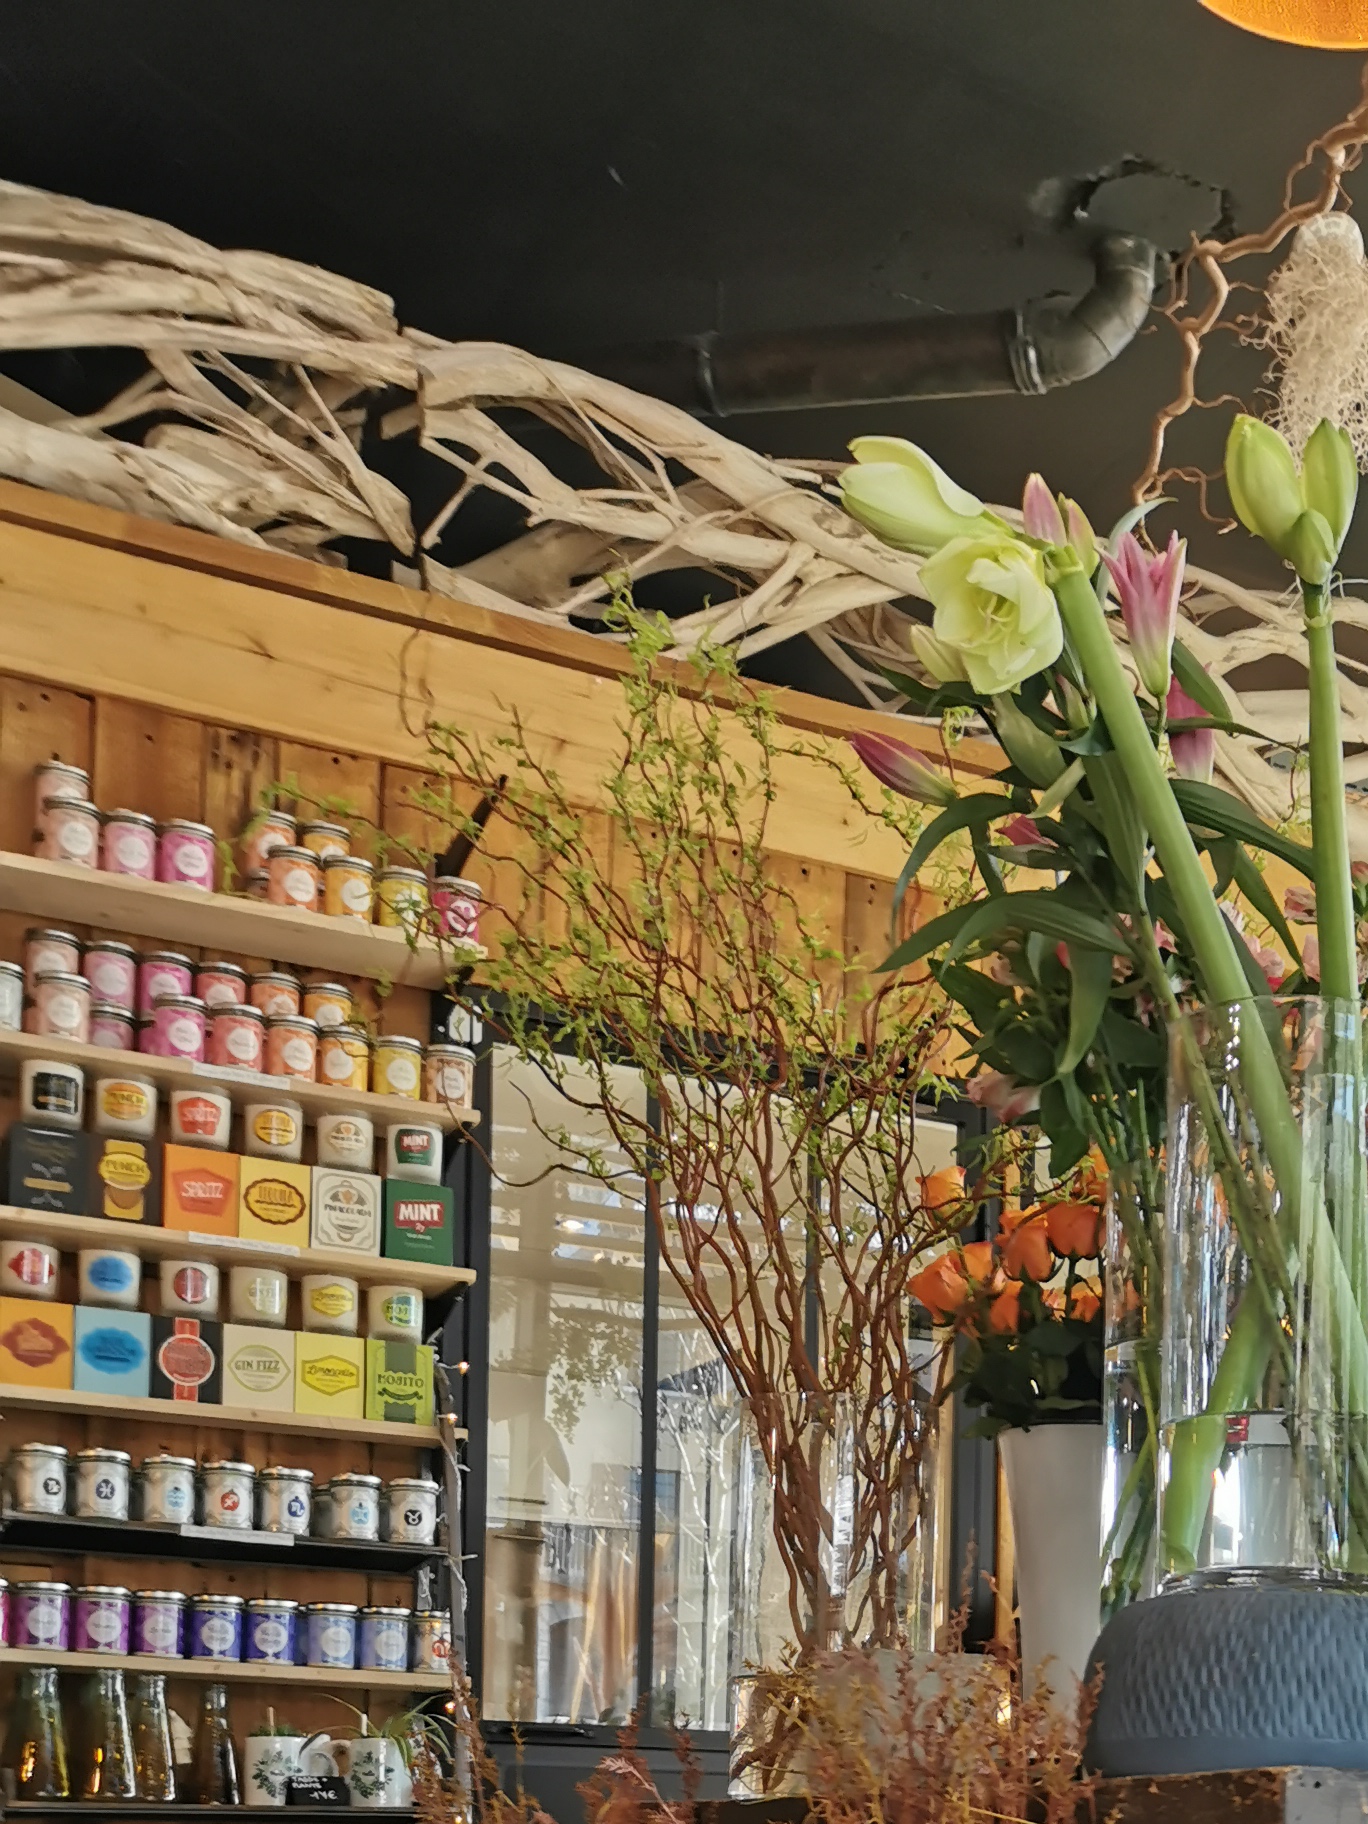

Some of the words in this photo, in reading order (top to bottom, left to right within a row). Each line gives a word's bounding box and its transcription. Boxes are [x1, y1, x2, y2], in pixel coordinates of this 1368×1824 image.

[403, 1135, 429, 1147] MINT
[180, 1181, 225, 1198] SPRITZ
[399, 1203, 441, 1222] MINT
[234, 1359, 254, 1371] GIN
[256, 1360, 281, 1373] FIZZ
[377, 1373, 425, 1389] MOJITO
